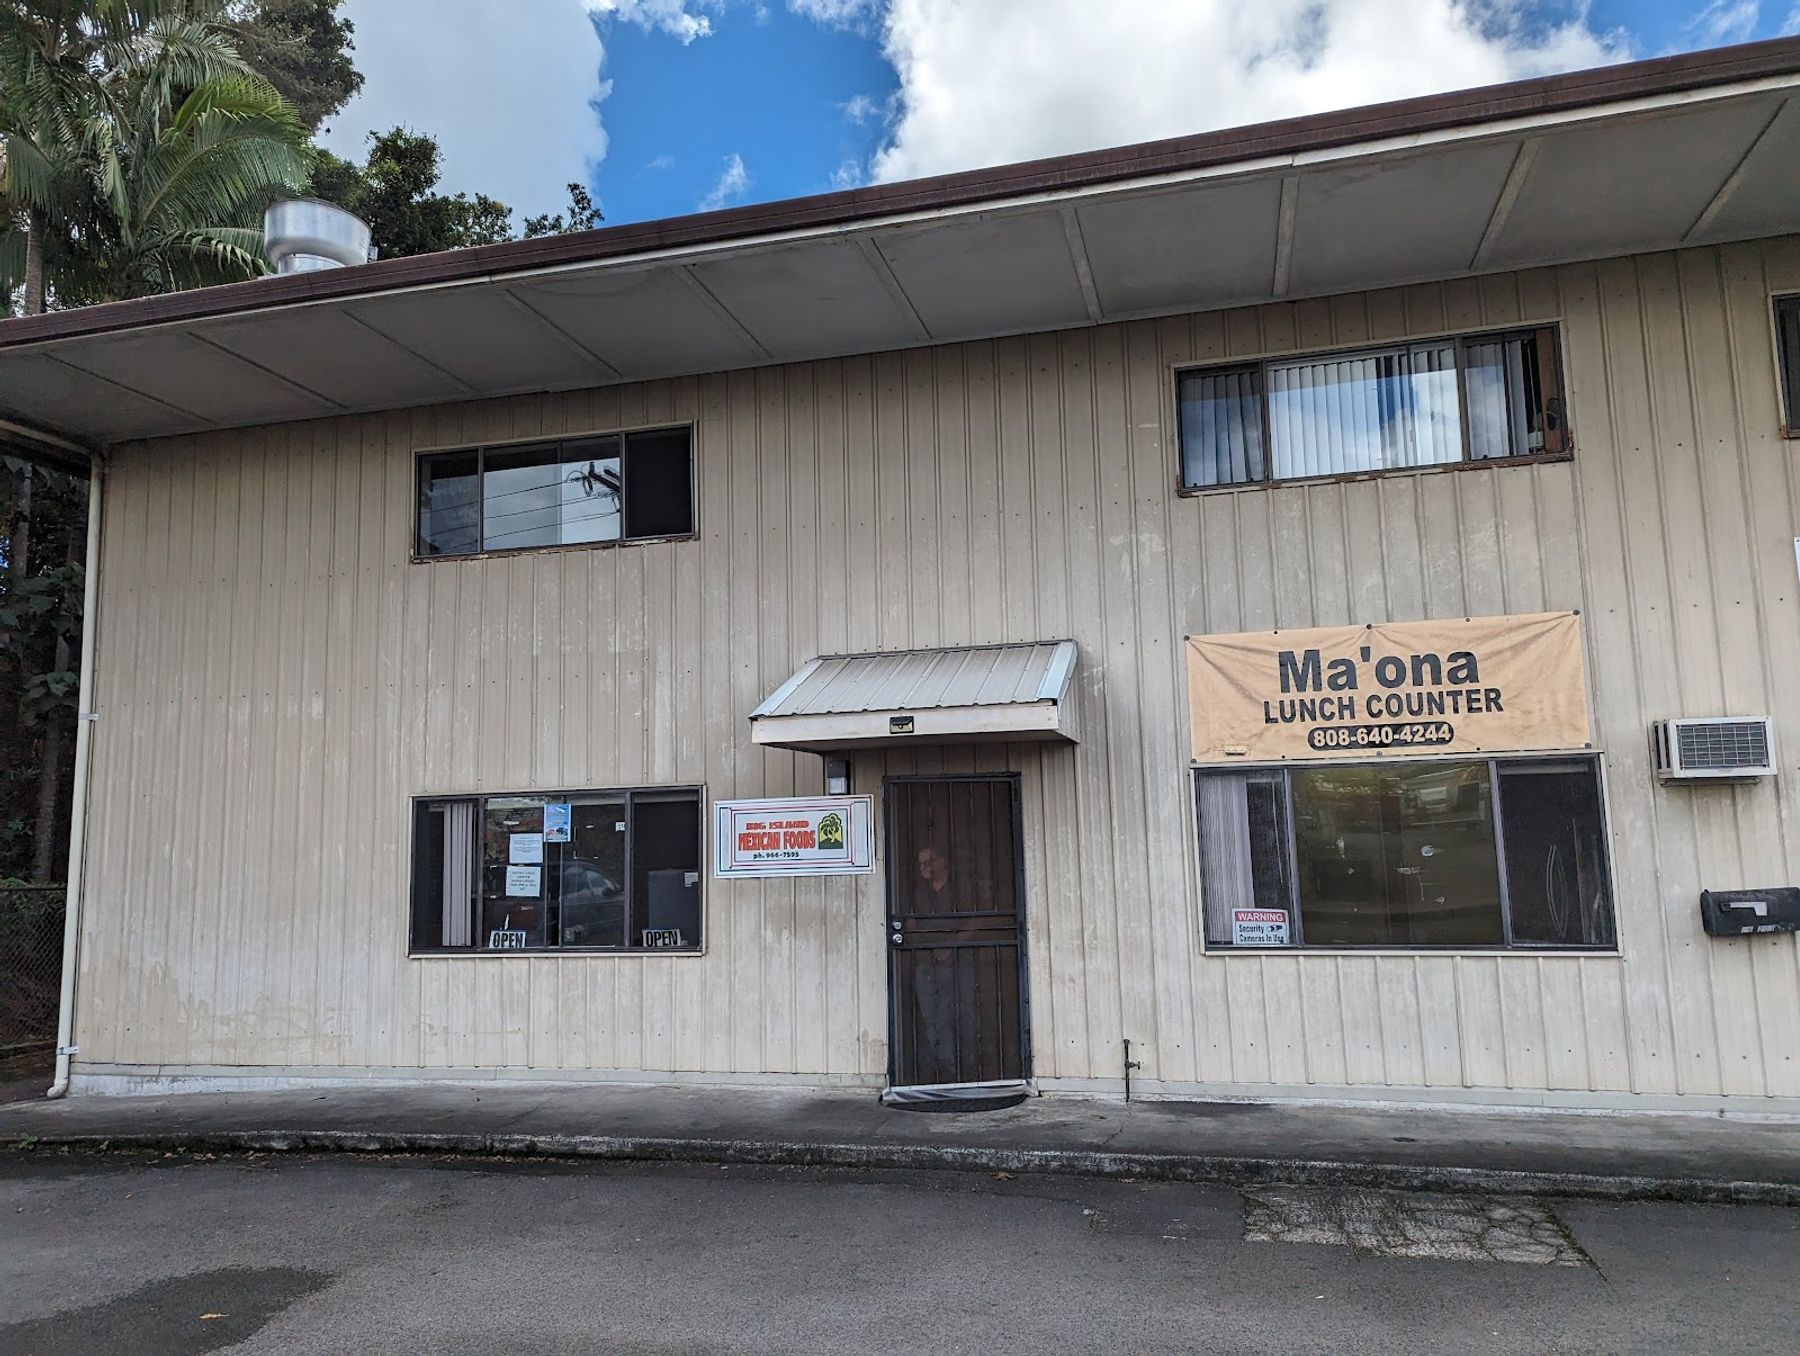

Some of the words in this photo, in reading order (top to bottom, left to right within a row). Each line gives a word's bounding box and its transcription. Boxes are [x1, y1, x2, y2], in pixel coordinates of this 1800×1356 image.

[1278, 645, 1480, 694] Ma'ona
[1264, 695, 1355, 724] LUNCH
[1366, 688, 1504, 718] COUNTER
[1313, 723, 1451, 747] 808-640-4244
[746, 822, 767, 831] BIG
[769, 820, 810, 830] ISLAND
[738, 831, 780, 851] MEXICAN
[783, 830, 816, 850] FOODS
[753, 852, 765, 860] ph.
[766, 851, 800, 859] 966-7595
[1237, 912, 1284, 922] WARNING
[1238, 924, 1265, 933] Security
[492, 932, 524, 948] OPEN
[645, 930, 679, 947] OPEN
[1239, 934, 1265, 943] Cameras
[1266, 934, 1272, 943] In
